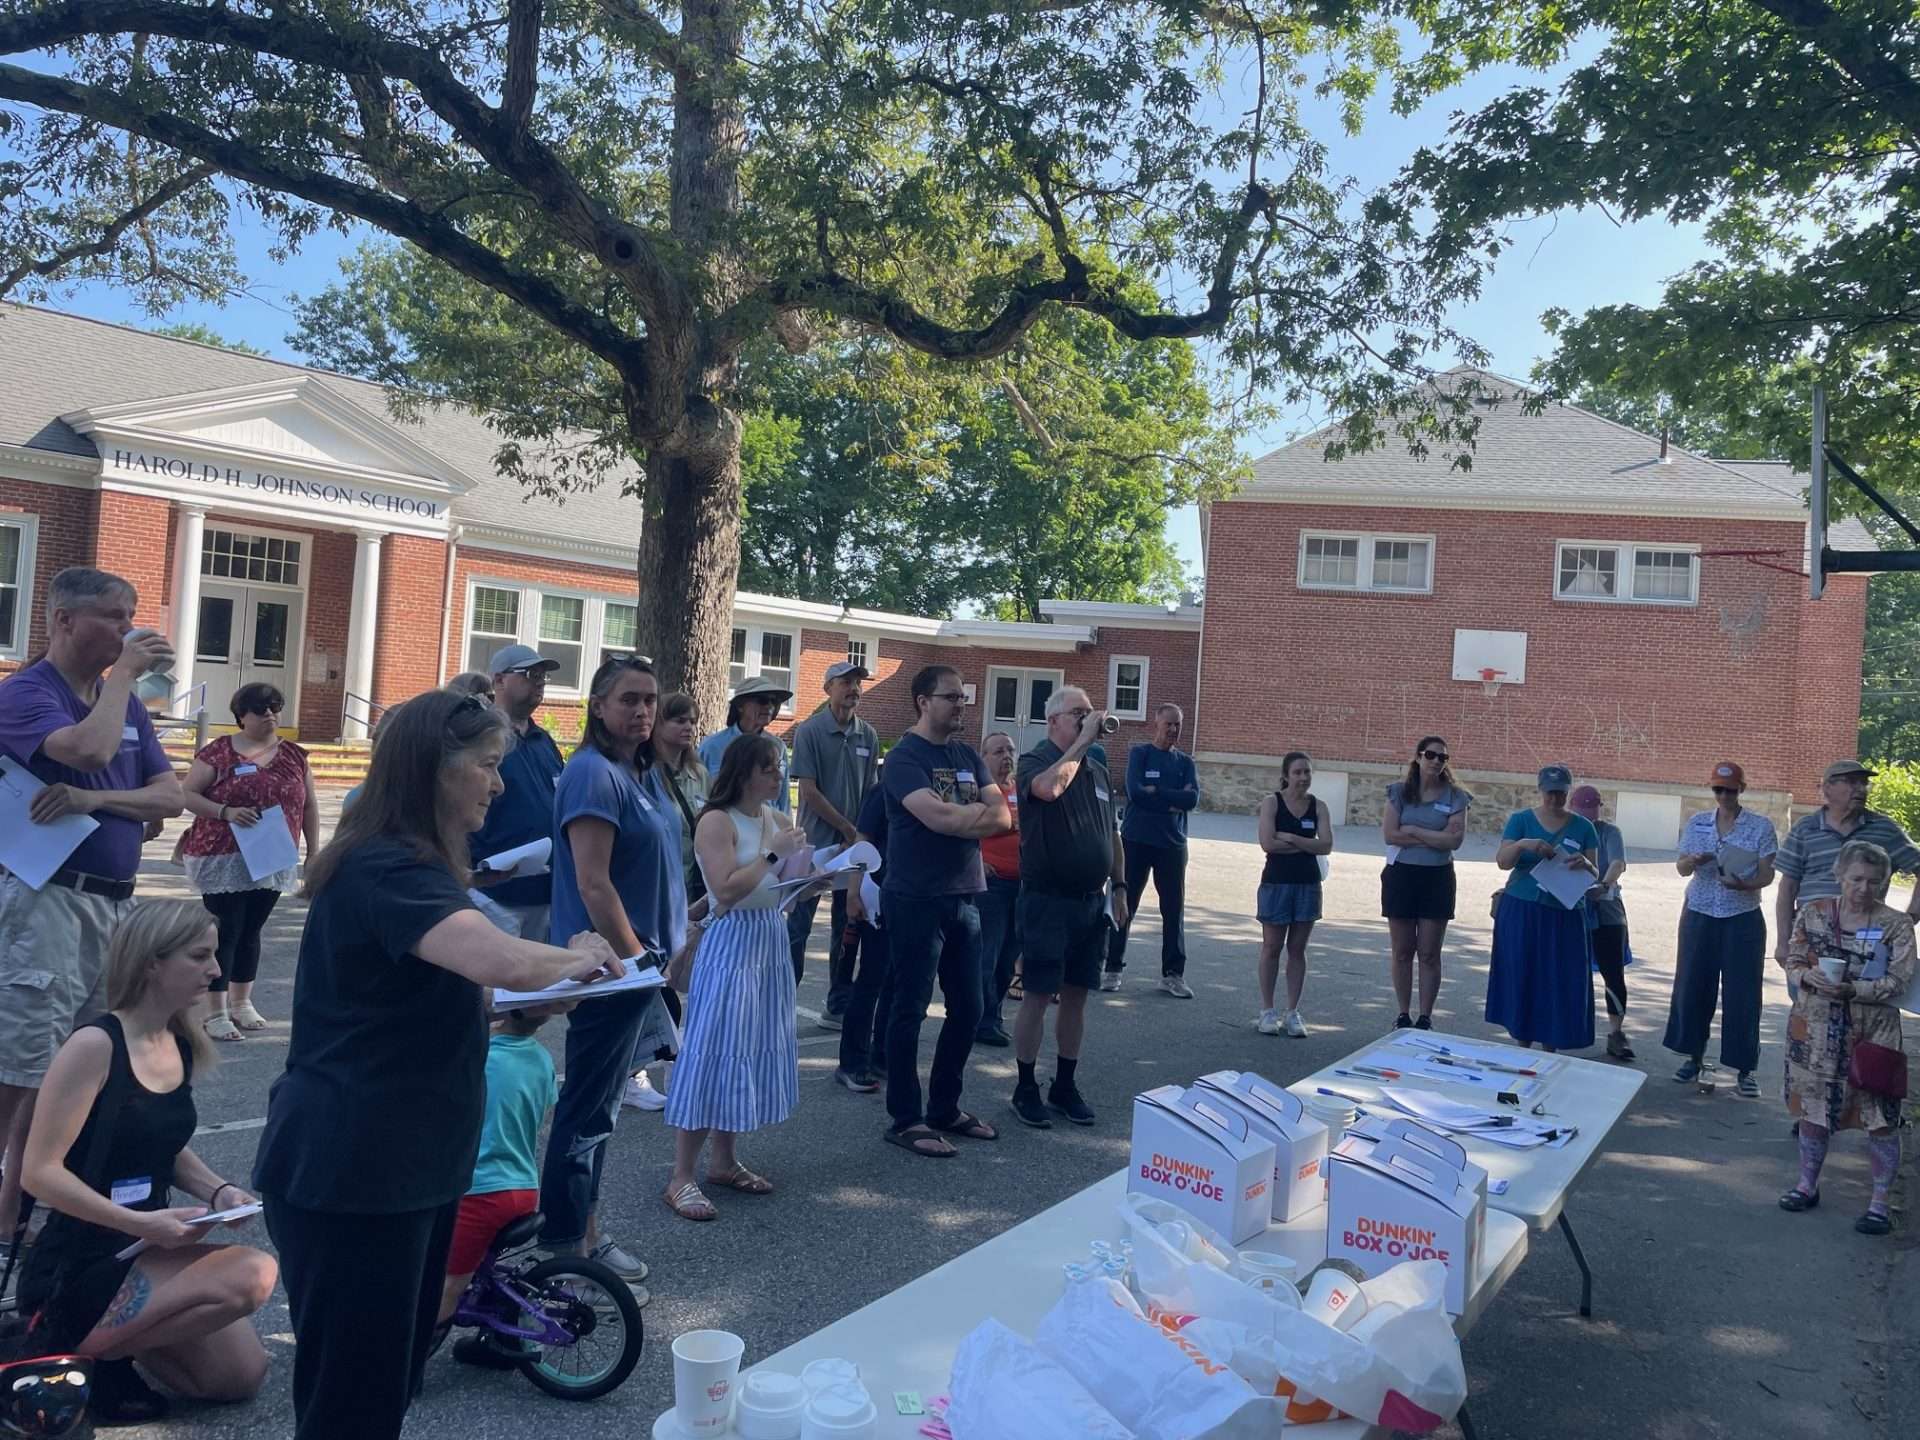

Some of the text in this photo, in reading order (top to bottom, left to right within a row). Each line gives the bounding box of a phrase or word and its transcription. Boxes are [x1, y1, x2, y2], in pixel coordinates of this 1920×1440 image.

[114, 450, 219, 484] HAROLD
[247, 473, 353, 505] JOHNSON
[359, 491, 444, 520] SCHOOL
[1140, 1164, 1172, 1187] BOX
[1152, 1154, 1214, 1182] DUNKIN'
[1343, 1231, 1382, 1253] BOX
[1357, 1216, 1436, 1246] DUNKIN'
